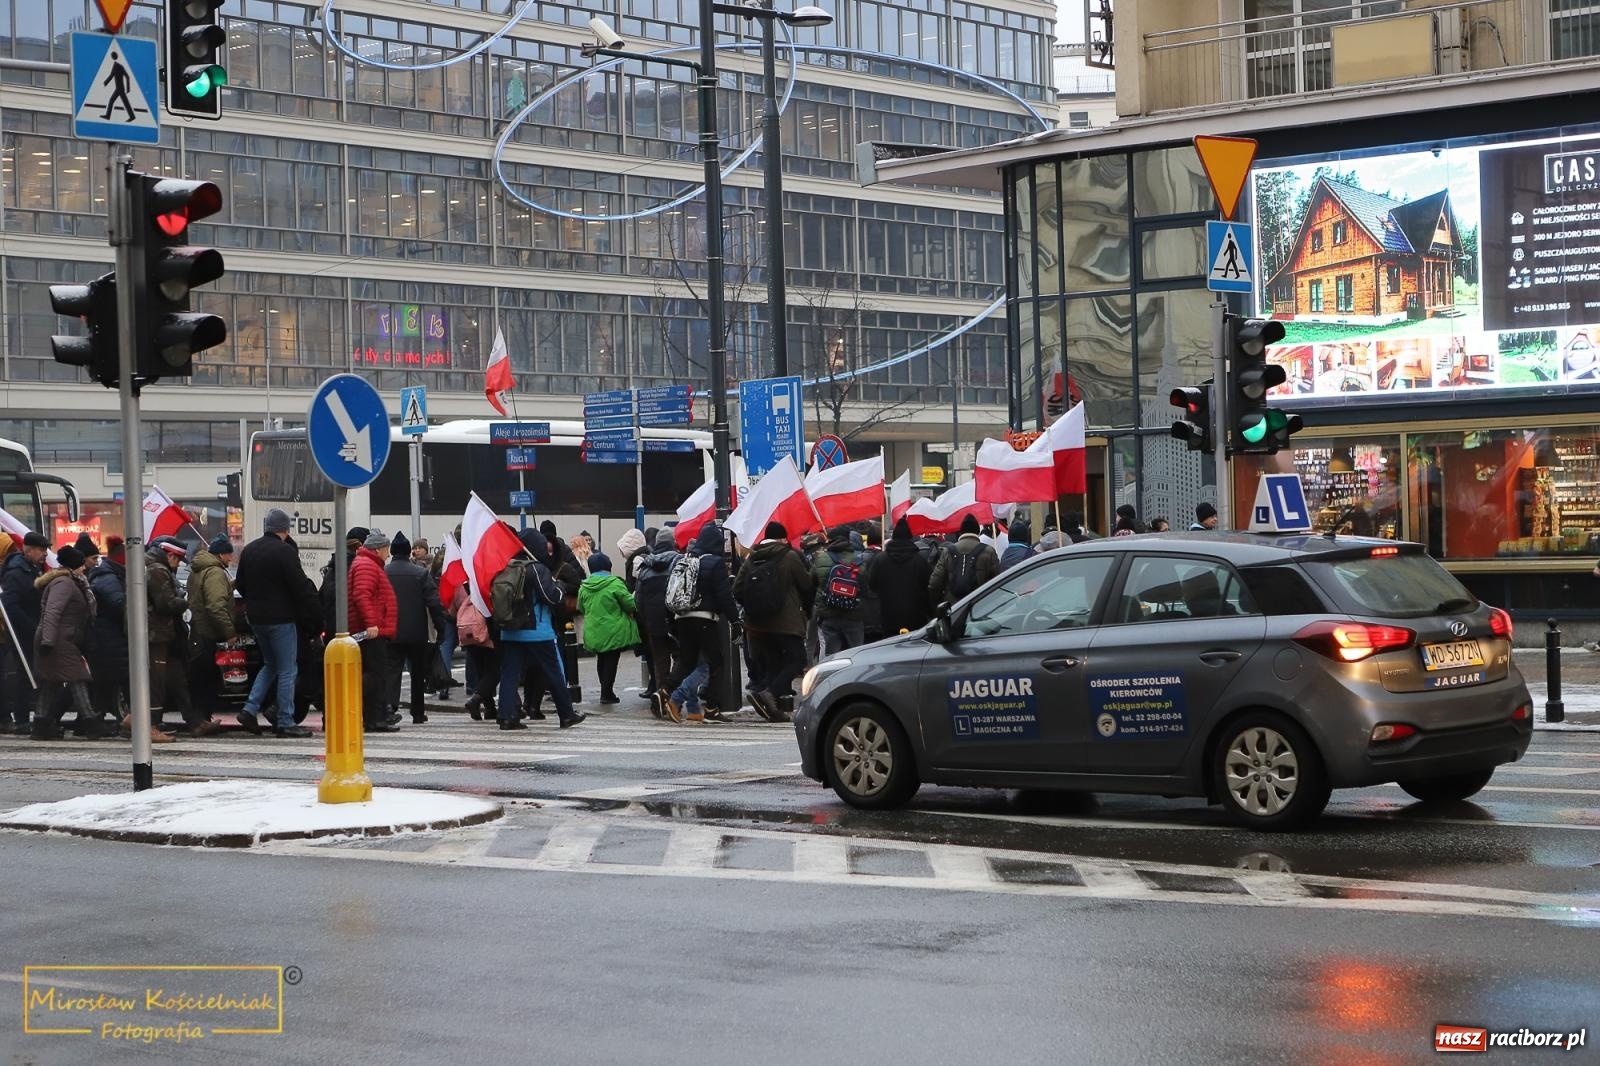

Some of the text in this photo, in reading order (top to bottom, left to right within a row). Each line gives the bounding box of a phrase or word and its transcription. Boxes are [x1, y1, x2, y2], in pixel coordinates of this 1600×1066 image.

[1554, 157, 1596, 184] CAS
[1577, 202, 1597, 211] DOMY
[1534, 249, 1564, 258] PUSZCZA
[1534, 266, 1557, 275] SAUNA
[1534, 276, 1558, 285] BILARD
[775, 415, 790, 425] BUS
[495, 427, 511, 438] Aleje
[774, 425, 791, 433] TAXI
[593, 440, 616, 449] Centrum
[1276, 485, 1300, 520] L
[1259, 508, 1267, 521] L
[1429, 642, 1481, 665] WD 5672N
[1090, 676, 1181, 688] OŚRODEK SZKOLENIA
[1434, 673, 1480, 687] JAGUAR
[949, 678, 1034, 698] JAGUAR
[1110, 687, 1163, 698] KIEROWCÓW
[958, 701, 1026, 711] www.oskjaguar.pl
[1103, 700, 1173, 711] oskjaguar@wp.pl
[974, 726, 1011, 734] MAGICZNA
